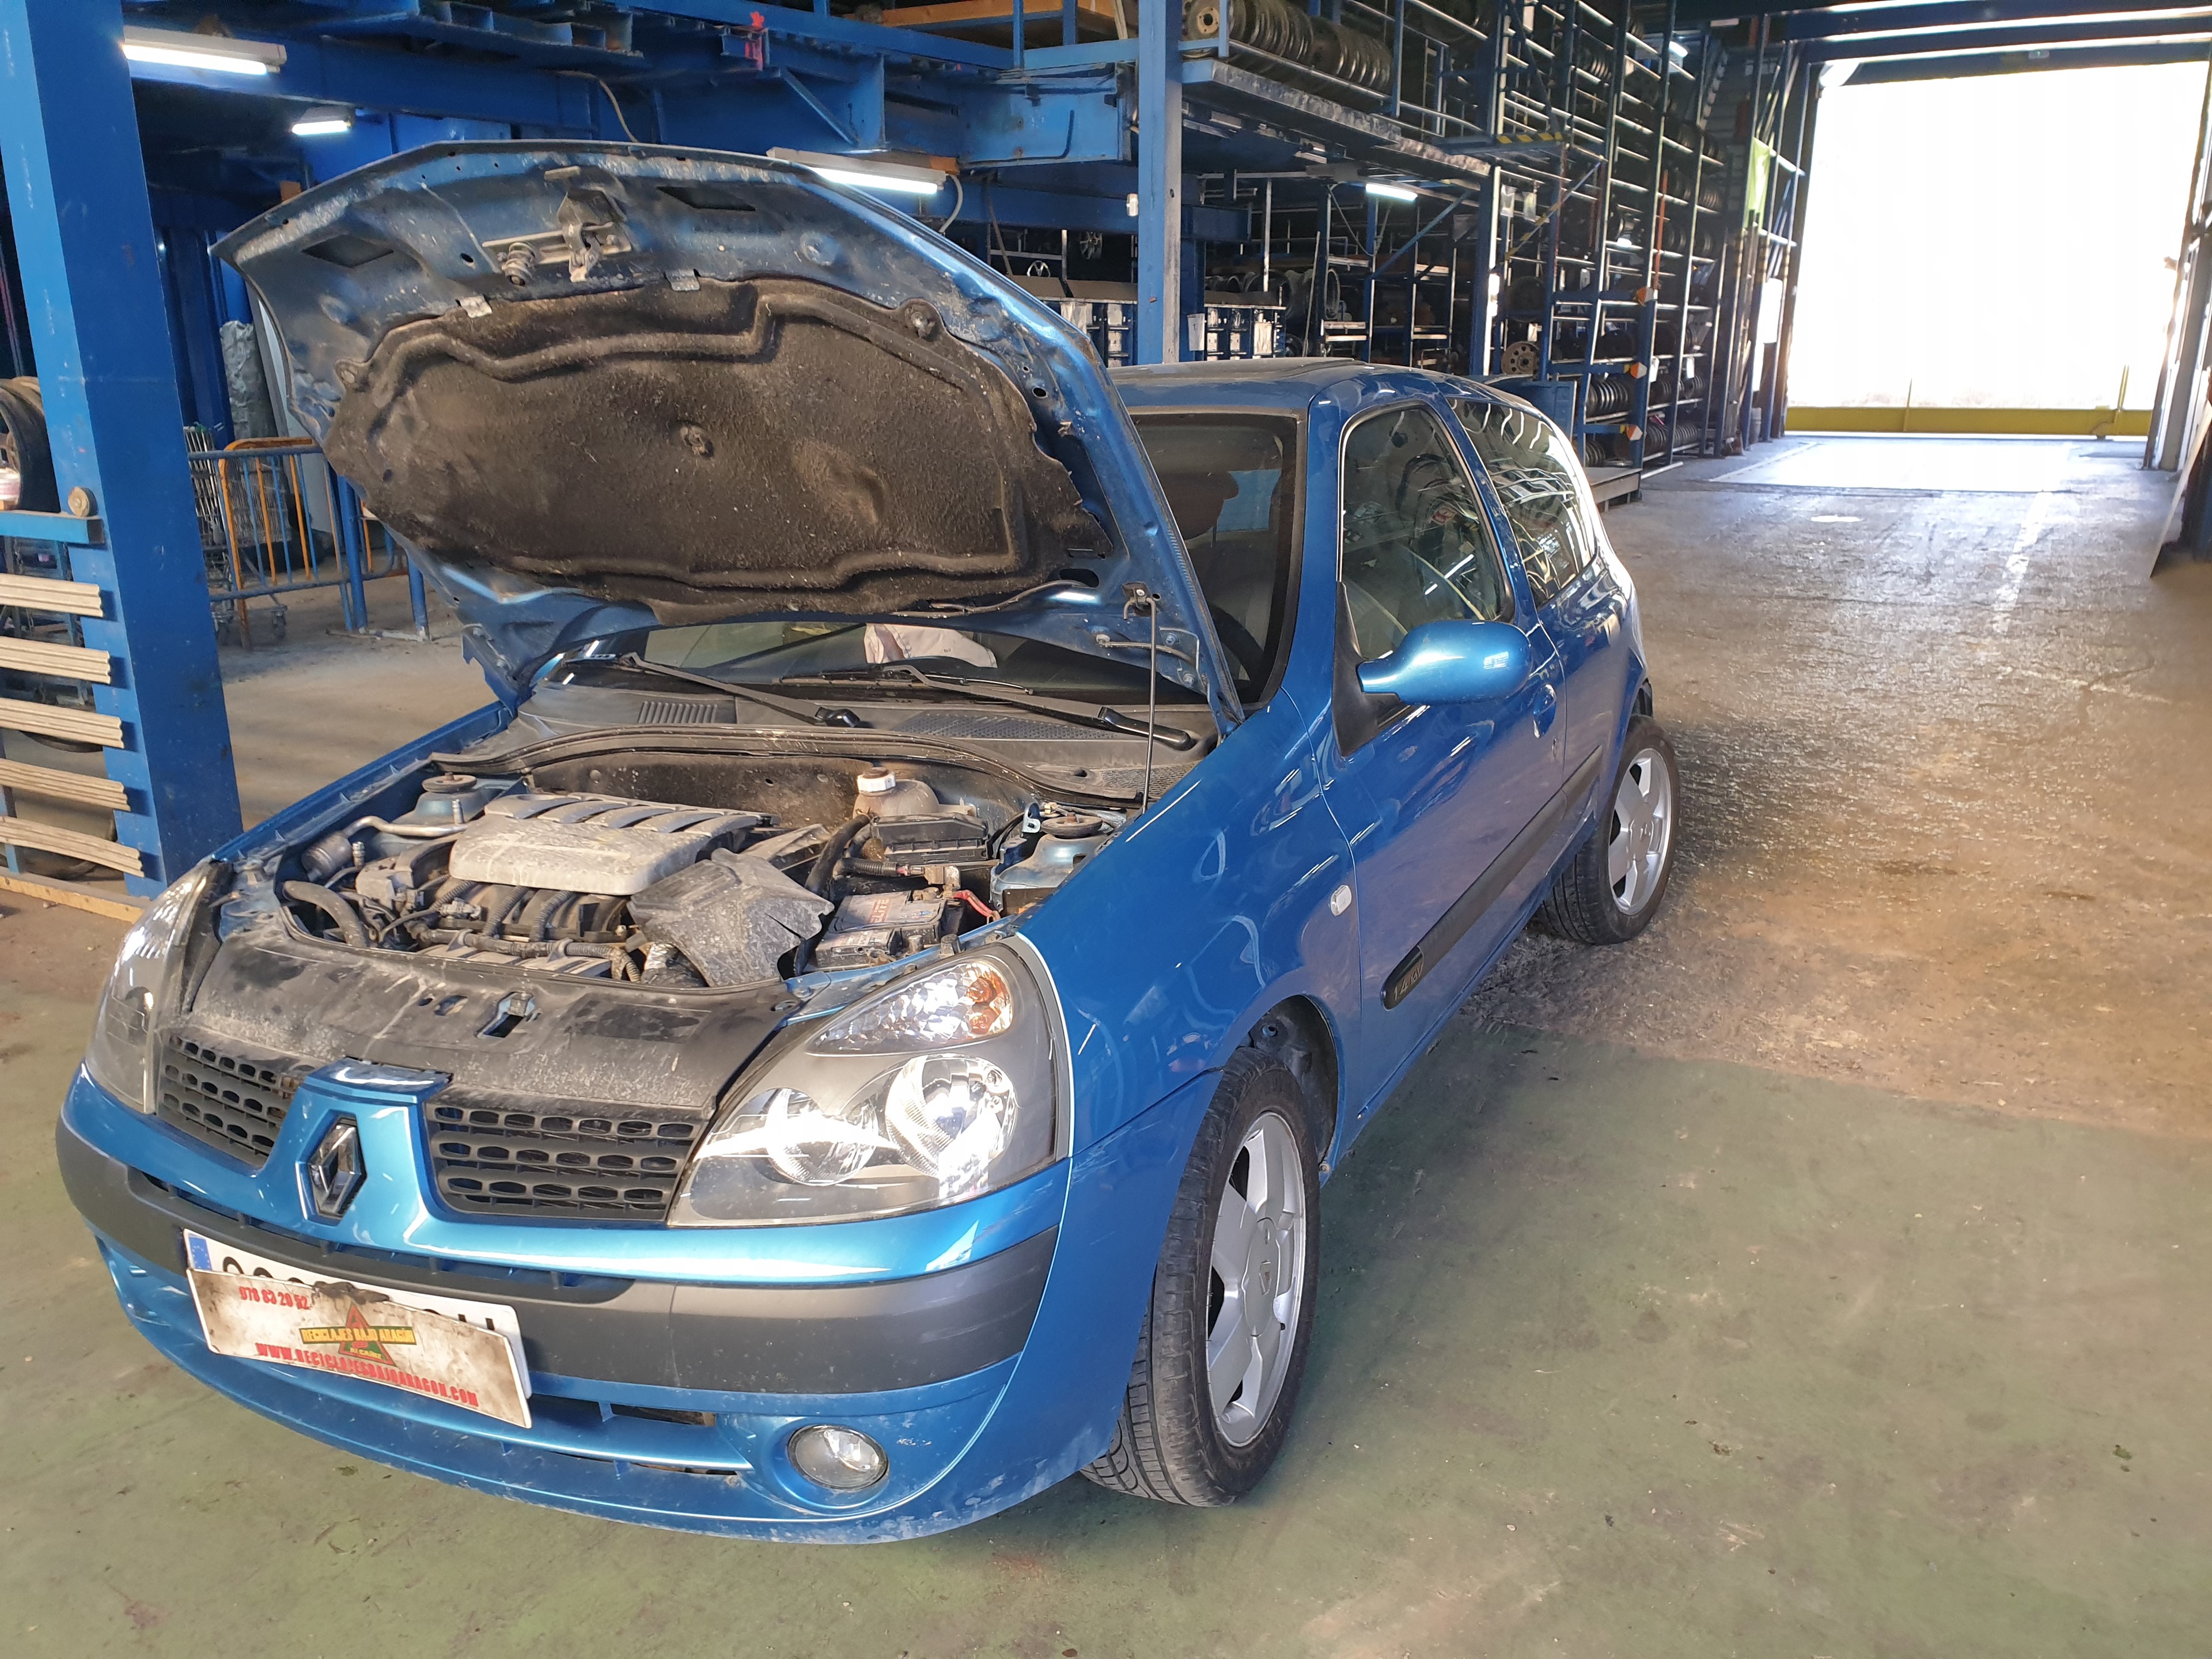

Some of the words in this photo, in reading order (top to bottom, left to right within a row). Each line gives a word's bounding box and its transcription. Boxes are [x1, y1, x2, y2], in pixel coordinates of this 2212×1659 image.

[1394, 979, 1408, 1001] 1.4
[278, 1291, 293, 1307] 20
[294, 1294, 310, 1309] 52
[301, 1328, 354, 1342] RECICLAJES
[353, 1328, 378, 1342] BAJO
